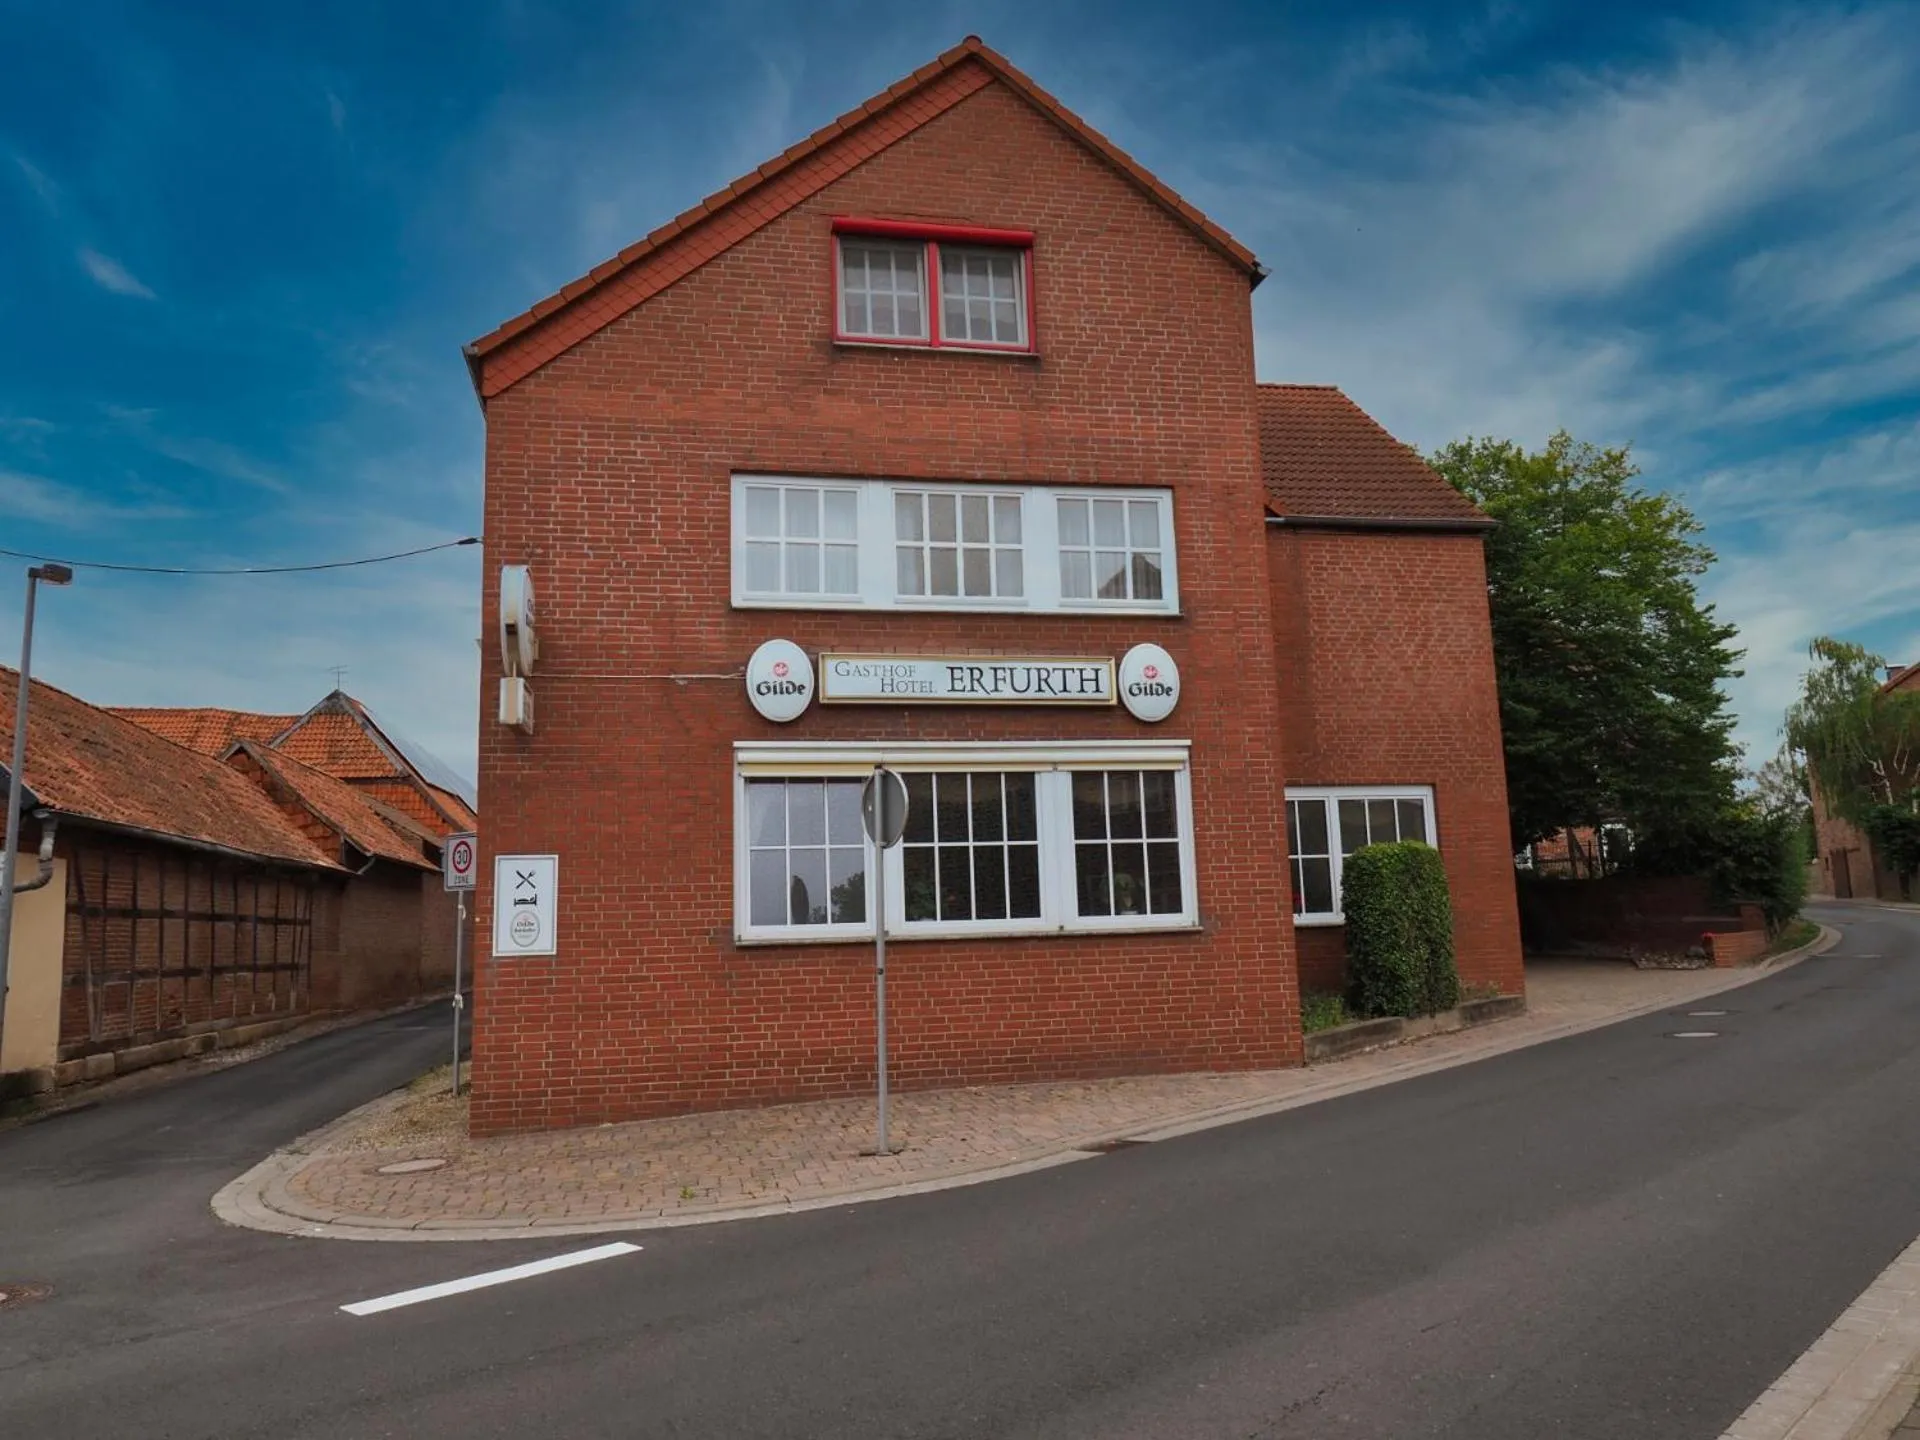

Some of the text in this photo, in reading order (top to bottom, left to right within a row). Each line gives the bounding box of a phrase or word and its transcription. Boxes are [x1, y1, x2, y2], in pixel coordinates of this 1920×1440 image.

[835, 661, 917, 678] GASTHOF
[756, 680, 807, 696] Gilde
[880, 678, 935, 694] HOTEL
[946, 666, 1104, 696] ERFURTH
[1128, 682, 1174, 698] Gilde
[456, 849, 468, 865] 30
